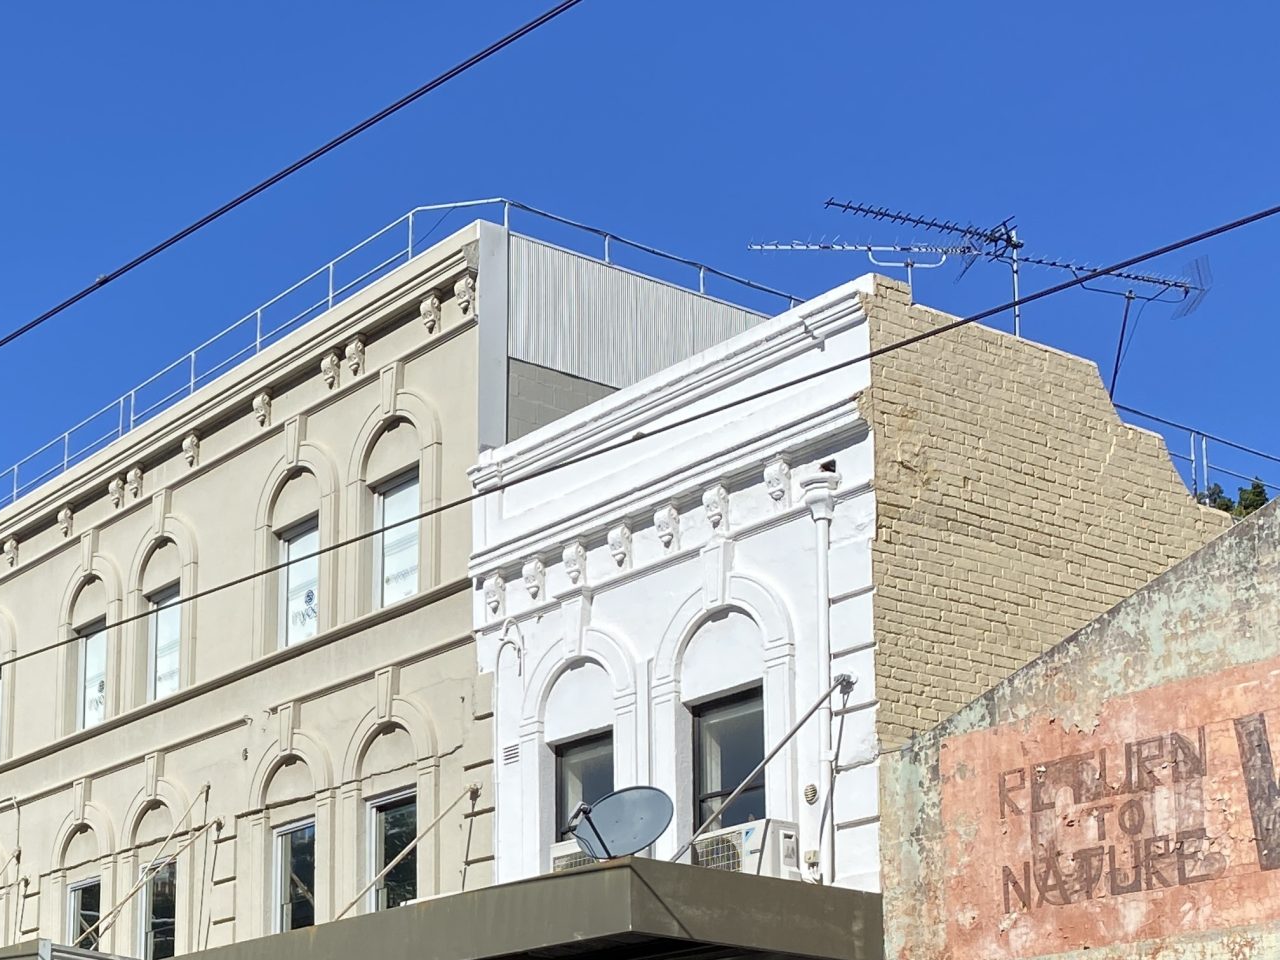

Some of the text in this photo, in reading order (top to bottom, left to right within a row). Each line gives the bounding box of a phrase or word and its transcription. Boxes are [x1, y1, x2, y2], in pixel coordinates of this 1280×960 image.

[998, 725, 1206, 820] RETURN
[1078, 798, 1145, 842] TO
[1002, 827, 1226, 914] NATURE
